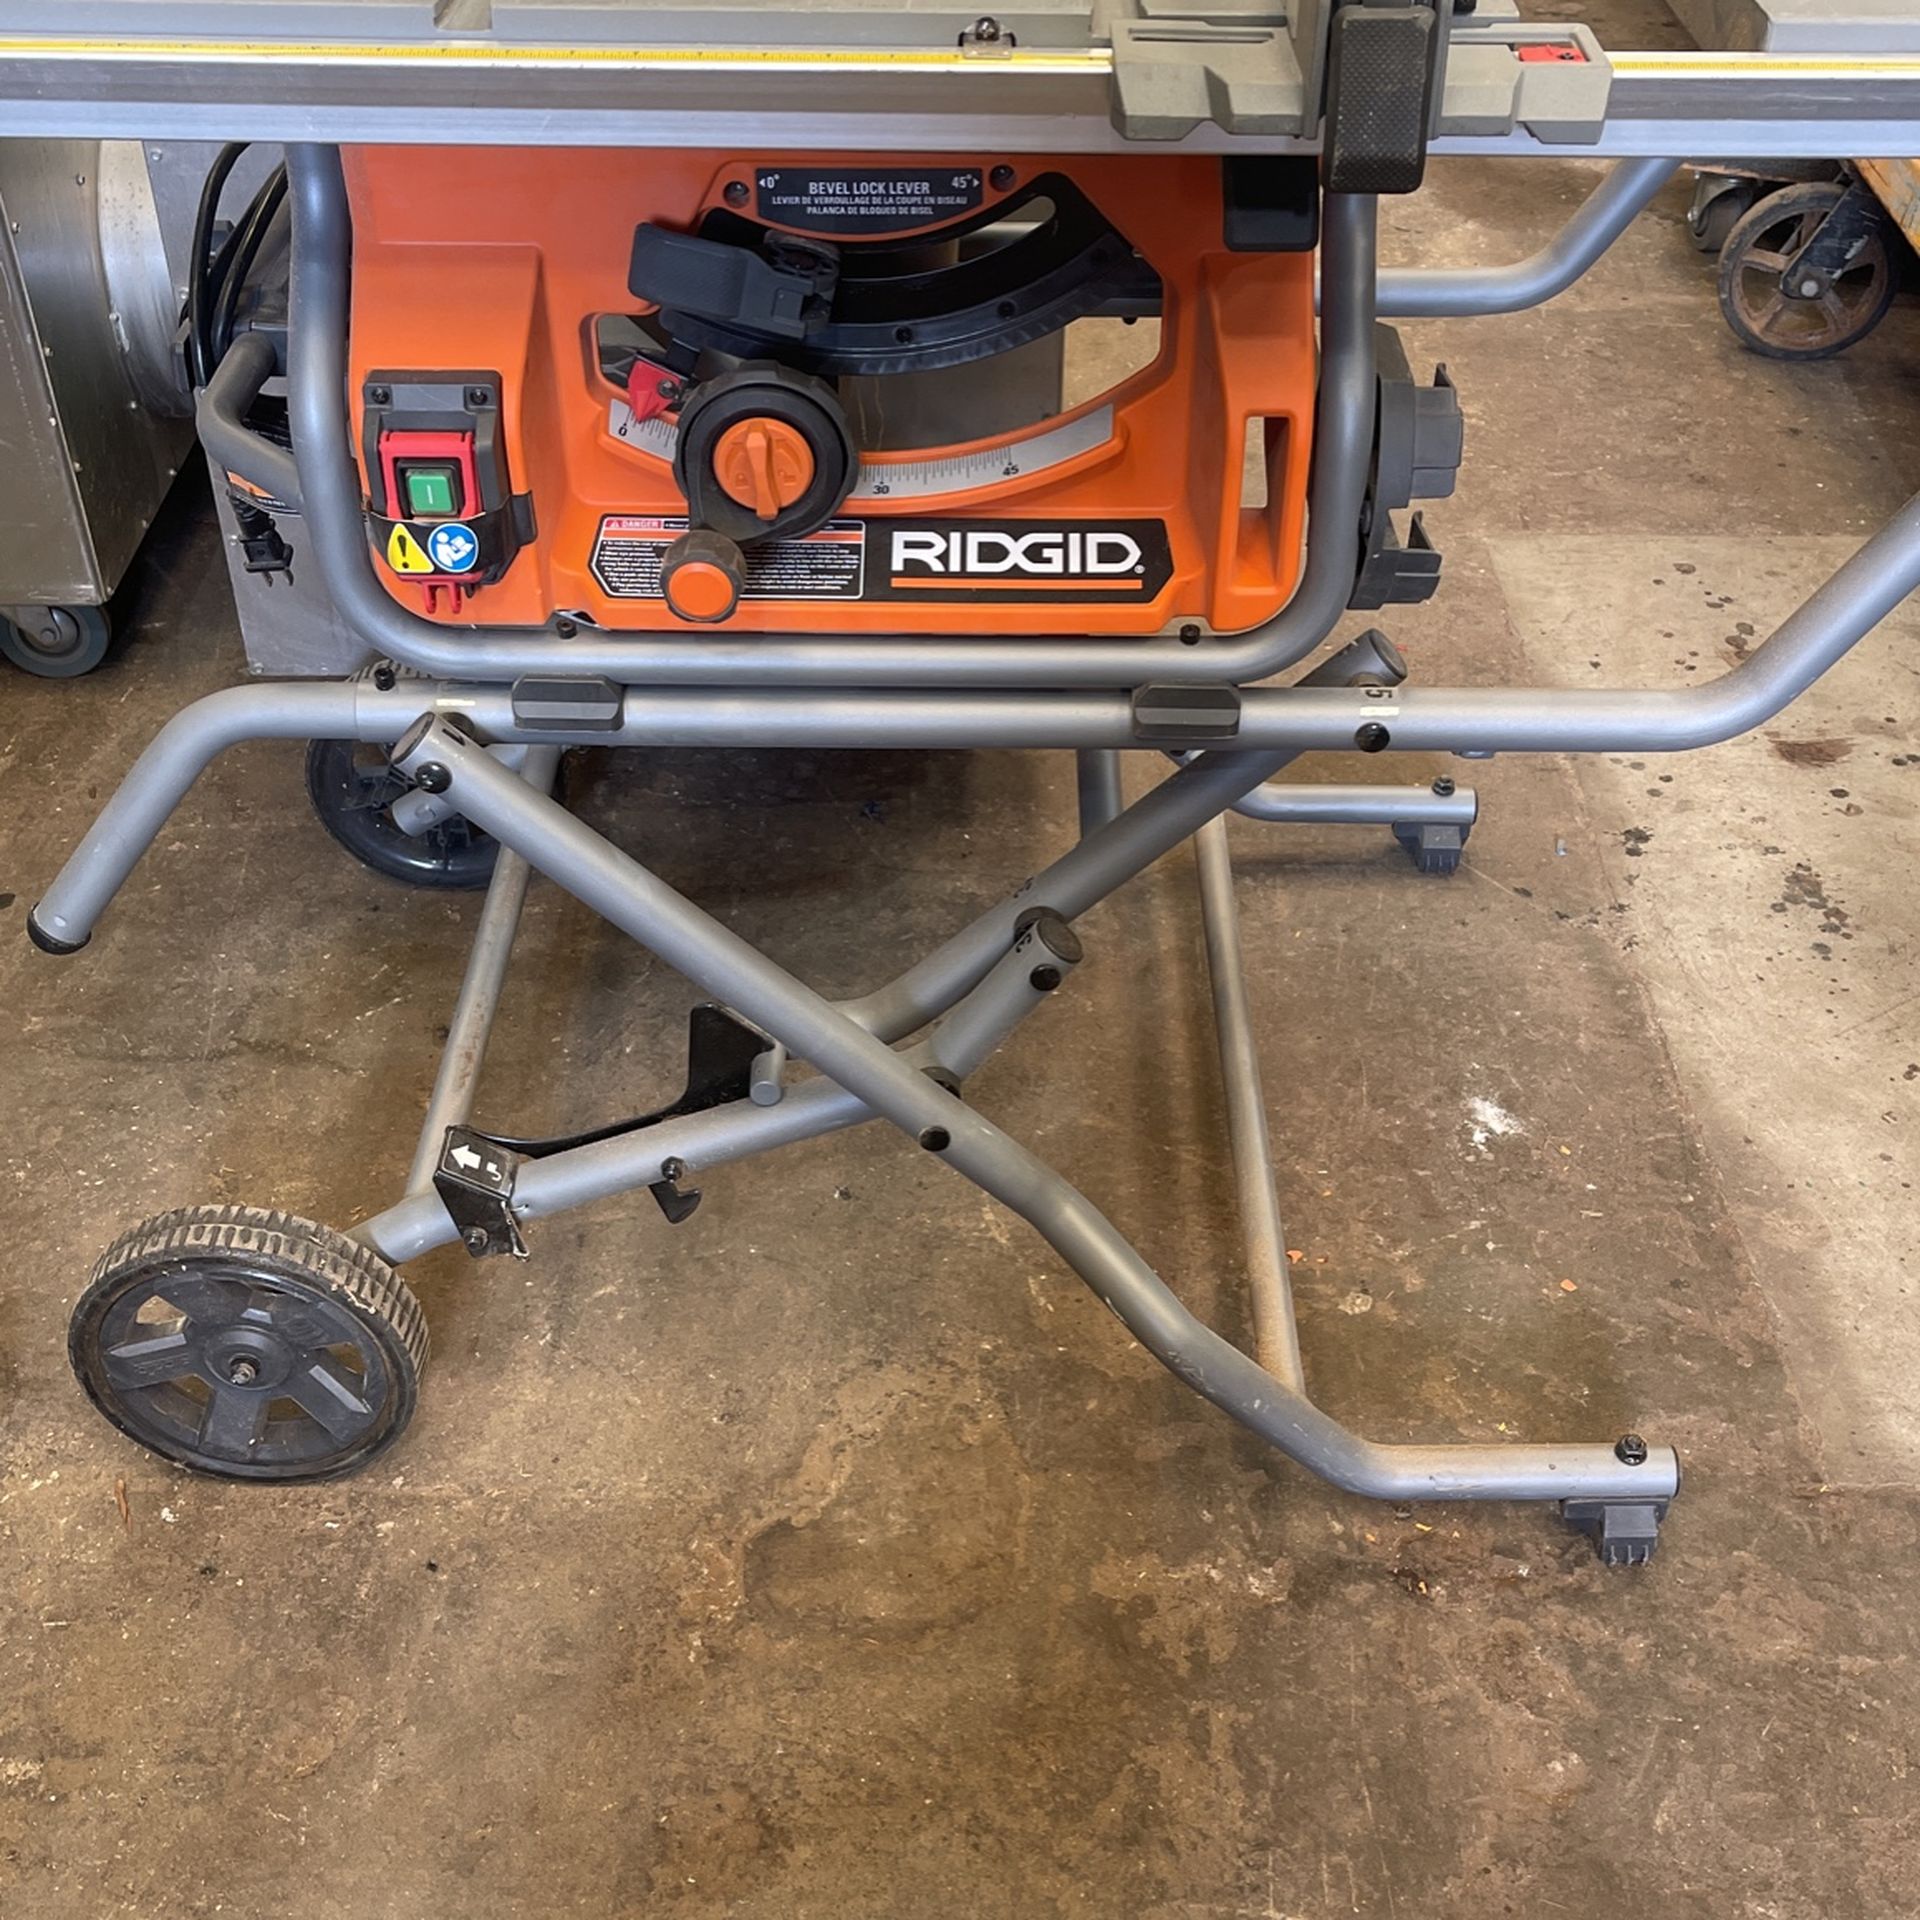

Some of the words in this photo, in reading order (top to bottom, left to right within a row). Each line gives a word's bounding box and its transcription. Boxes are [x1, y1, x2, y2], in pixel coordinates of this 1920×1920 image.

[809, 181, 850, 195] BEVEL
[853, 181, 886, 195] LOCK
[889, 181, 930, 195] LEVER
[802, 196, 812, 205] DE
[872, 196, 882, 205] DE
[883, 196, 894, 205] LA
[895, 196, 922, 205] COUPE
[923, 196, 935, 205] EN
[806, 206, 846, 215] PALANCA
[847, 206, 858, 215] DE
[860, 206, 897, 215] BLOQUEO
[898, 206, 909, 215] DE
[910, 206, 934, 215] BISEL
[618, 426, 628, 437] 0
[1002, 464, 1020, 476] 45
[872, 485, 890, 495] 30
[891, 531, 1142, 573] RIDGID
